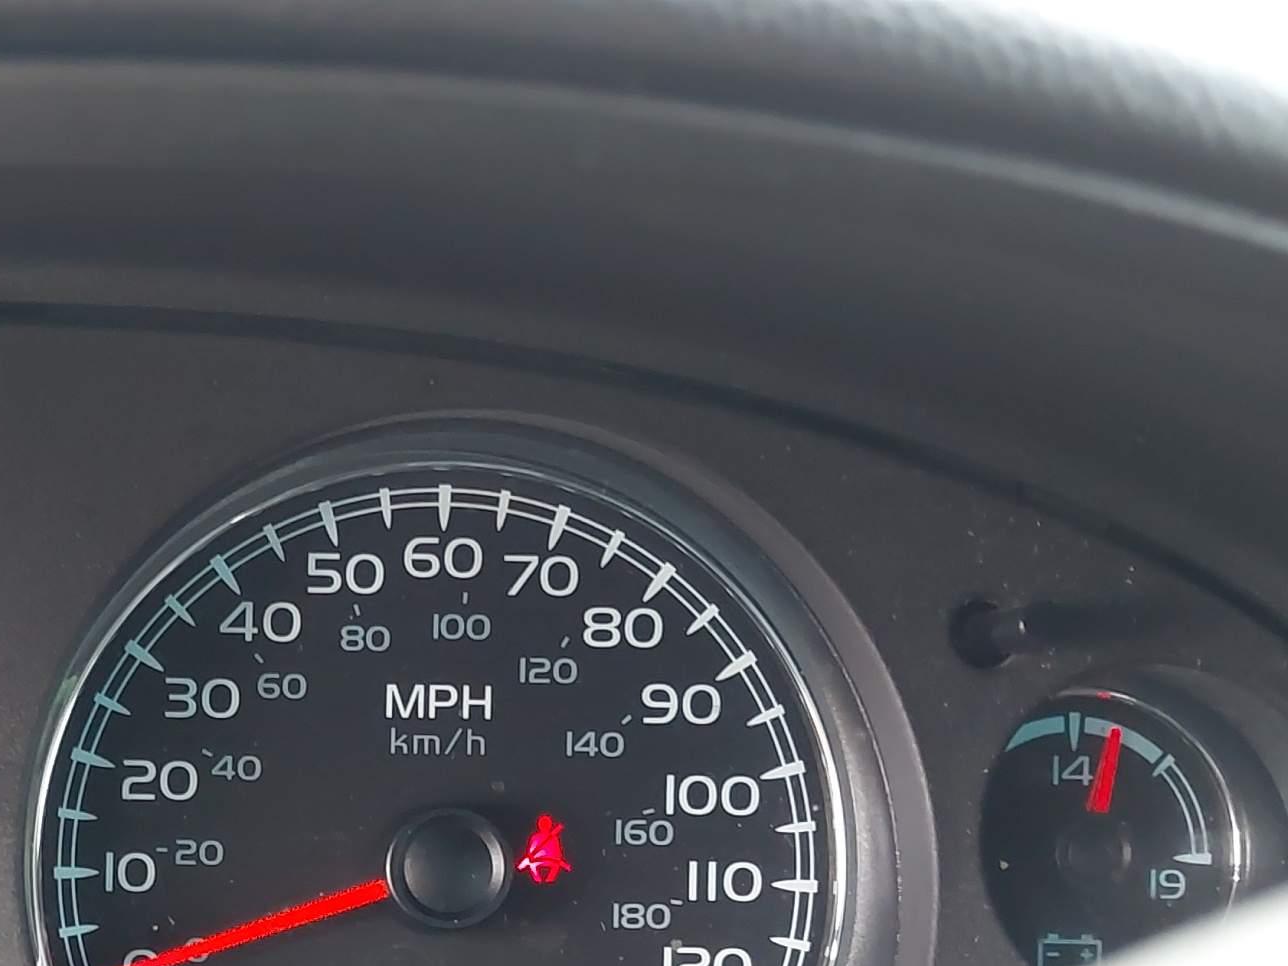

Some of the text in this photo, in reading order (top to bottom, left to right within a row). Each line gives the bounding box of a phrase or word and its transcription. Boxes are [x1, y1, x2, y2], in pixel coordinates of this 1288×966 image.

[307, 551, 385, 595] 50
[403, 537, 483, 580] 60
[504, 554, 580, 597] 70
[219, 601, 302, 643] 40
[340, 625, 391, 652] 80
[433, 613, 491, 641] 100
[583, 607, 663, 648] 80
[257, 673, 307, 700] 60
[519, 656, 578, 684] 120
[164, 677, 240, 719] 30
[386, 684, 492, 720] MPH
[641, 683, 721, 725] 90
[390, 727, 485, 757] km/h
[566, 731, 624, 758] 140
[121, 759, 199, 801] 20
[211, 755, 263, 782] 40
[1052, 755, 1094, 786] 14
[665, 774, 760, 816] 100
[616, 819, 674, 847] 160
[175, 840, 224, 866] 20
[105, 851, 157, 893] 10
[687, 861, 762, 904] 110
[1149, 869, 1186, 900] 19
[613, 903, 671, 931] 180
